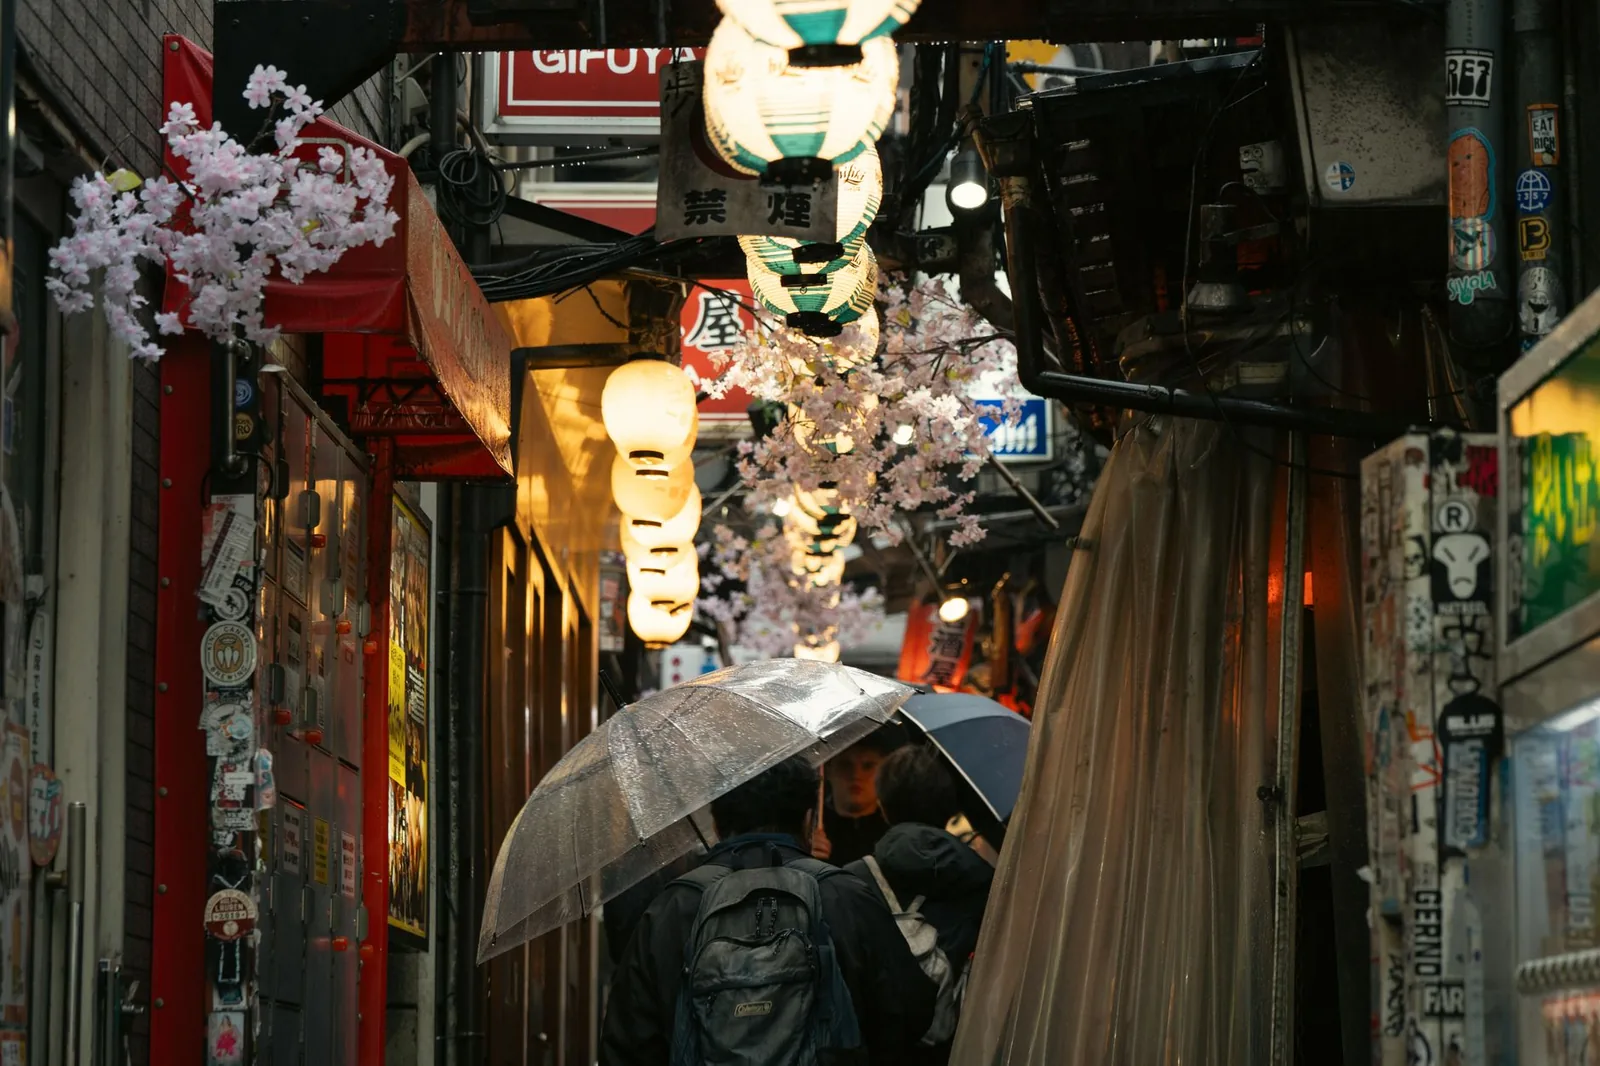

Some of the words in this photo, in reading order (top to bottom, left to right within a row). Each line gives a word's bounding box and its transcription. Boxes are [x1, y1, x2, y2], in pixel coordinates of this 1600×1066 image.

[1533, 117, 1553, 132] EAT
[1534, 136, 1555, 149] RICH
[684, 188, 811, 228] 禁煙
[687, 291, 742, 350] 屋
[1446, 507, 1462, 527] R
[207, 631, 220, 651] KING
[223, 626, 250, 649] CANARY
[210, 666, 248, 680] BREWING
